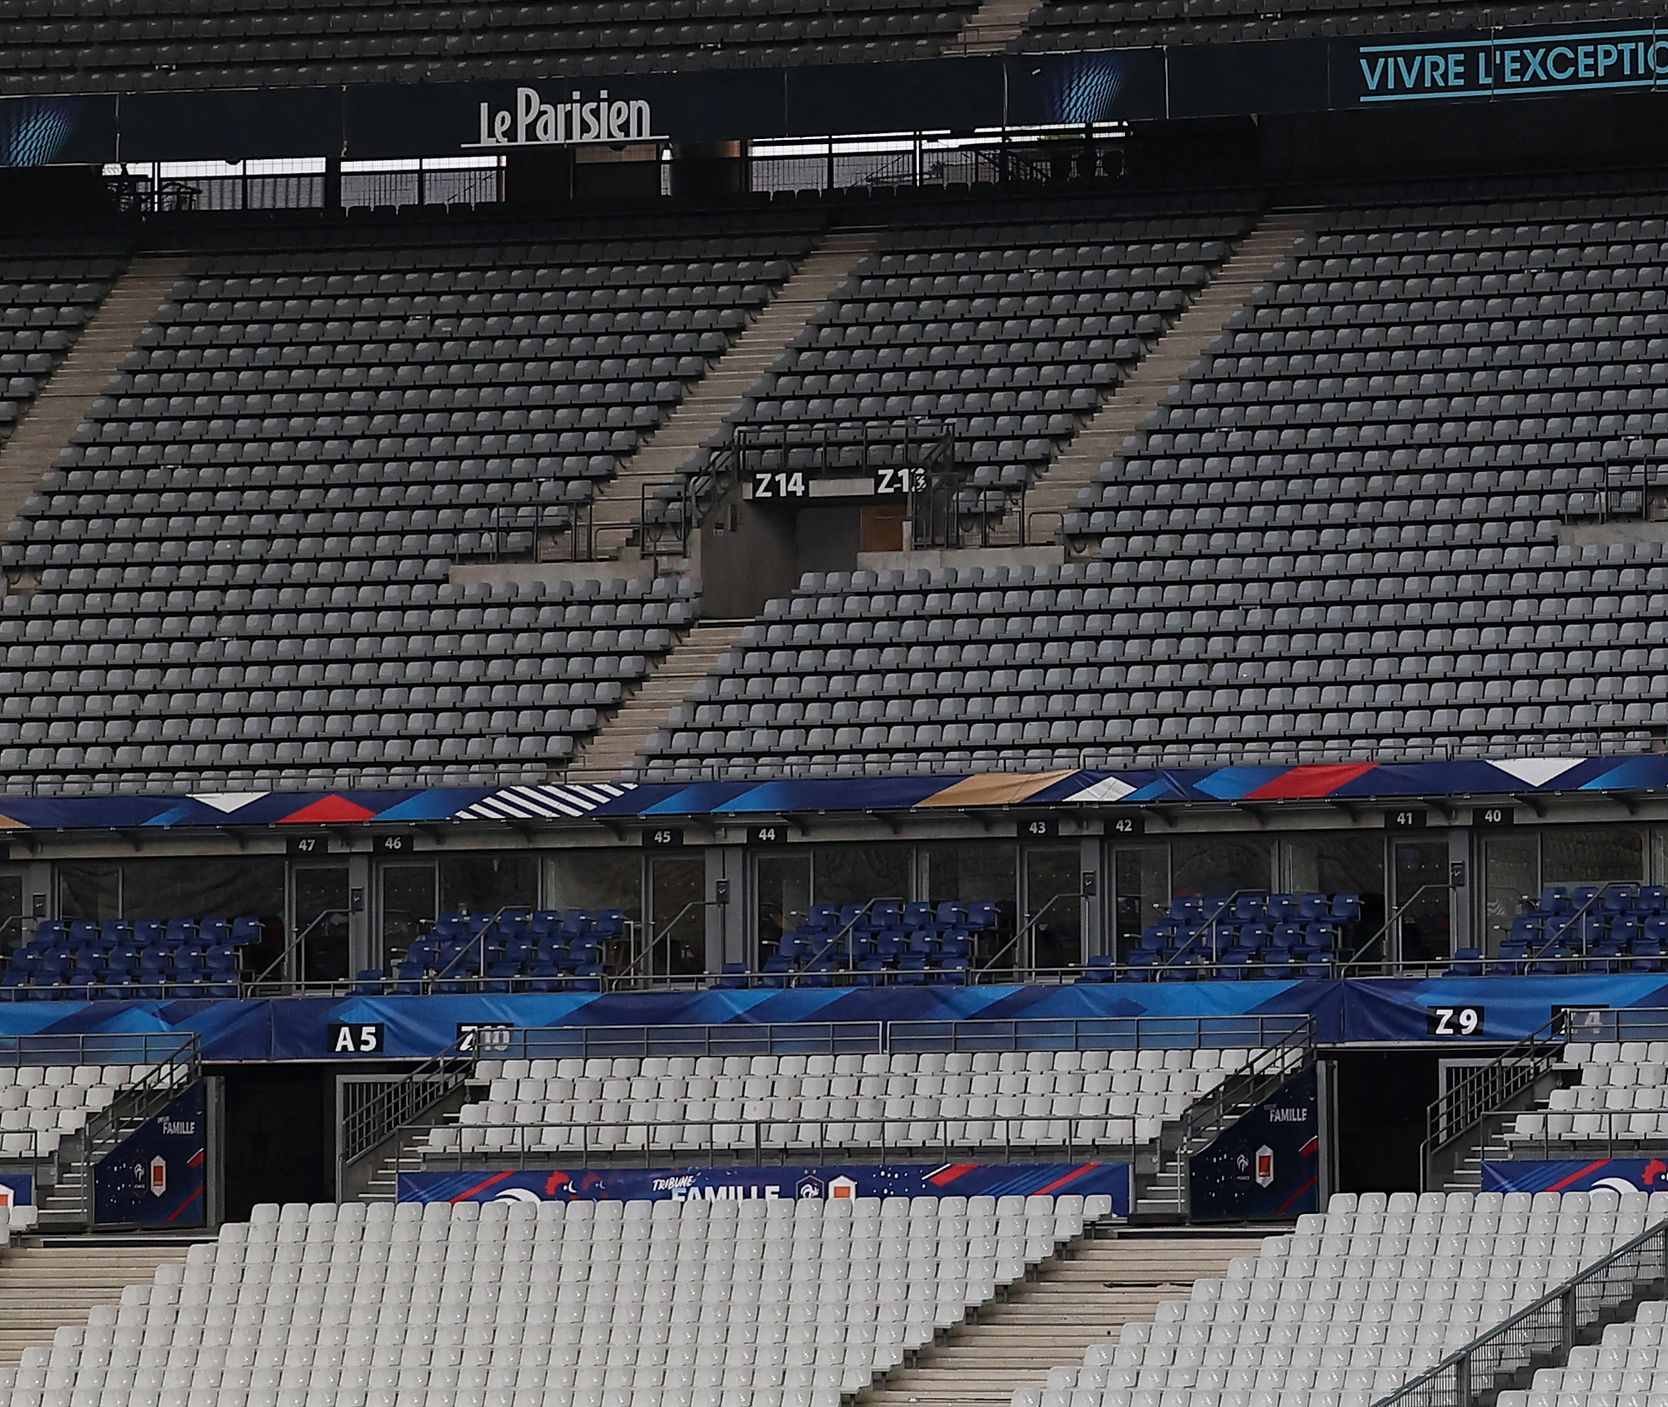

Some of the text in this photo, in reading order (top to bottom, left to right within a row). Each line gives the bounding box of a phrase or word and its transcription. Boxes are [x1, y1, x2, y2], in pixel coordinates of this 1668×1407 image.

[1360, 54, 1465, 91] VIVRE
[480, 87, 651, 144] Le Parisien
[755, 472, 805, 498] Z14
[1396, 812, 1412, 825] 41
[1484, 810, 1501, 822] 40
[1029, 822, 1046, 834] 43
[1116, 820, 1132, 832] 42
[654, 831, 671, 843] 45
[758, 828, 776, 841] 44
[298, 839, 315, 851] 47
[385, 837, 402, 849] 46
[1269, 1108, 1307, 1122] FAMILLE
[163, 1121, 195, 1135] FAMILLE
[652, 1175, 695, 1191] TRIBUNE
